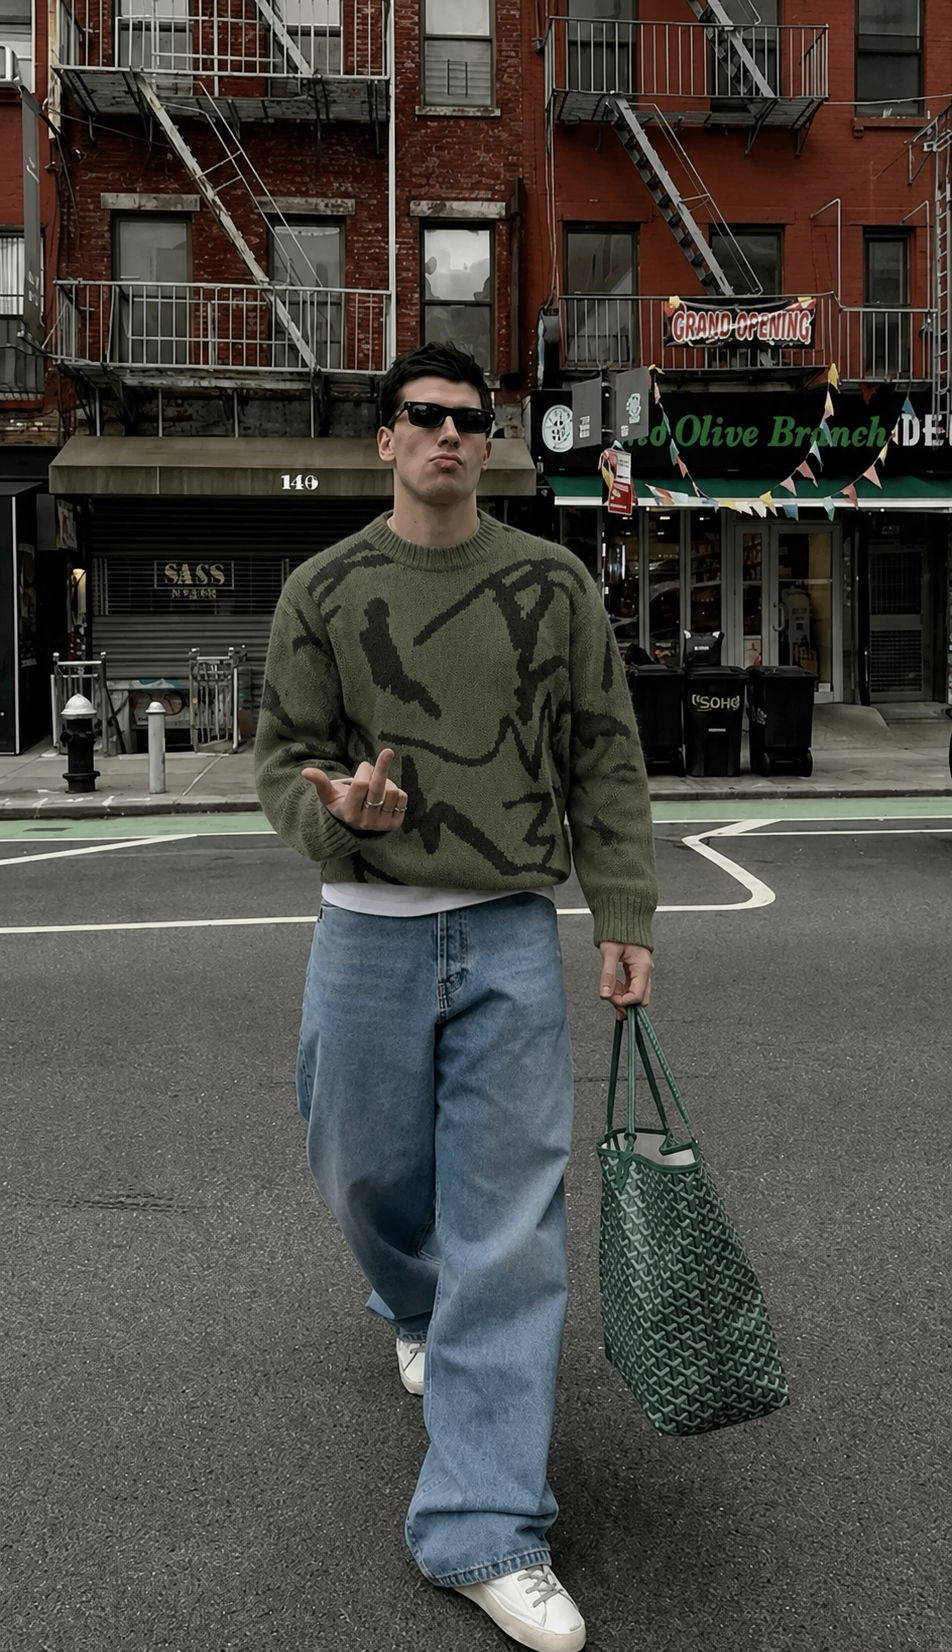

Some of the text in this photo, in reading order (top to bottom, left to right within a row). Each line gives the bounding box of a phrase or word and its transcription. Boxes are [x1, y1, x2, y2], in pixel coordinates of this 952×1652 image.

[672, 310, 812, 345] GRAND OPENING
[675, 414, 759, 447] Olive
[767, 415, 886, 447] Branch
[901, 413, 952, 447] DE
[281, 474, 319, 490] 140
[164, 563, 225, 585] SASS
